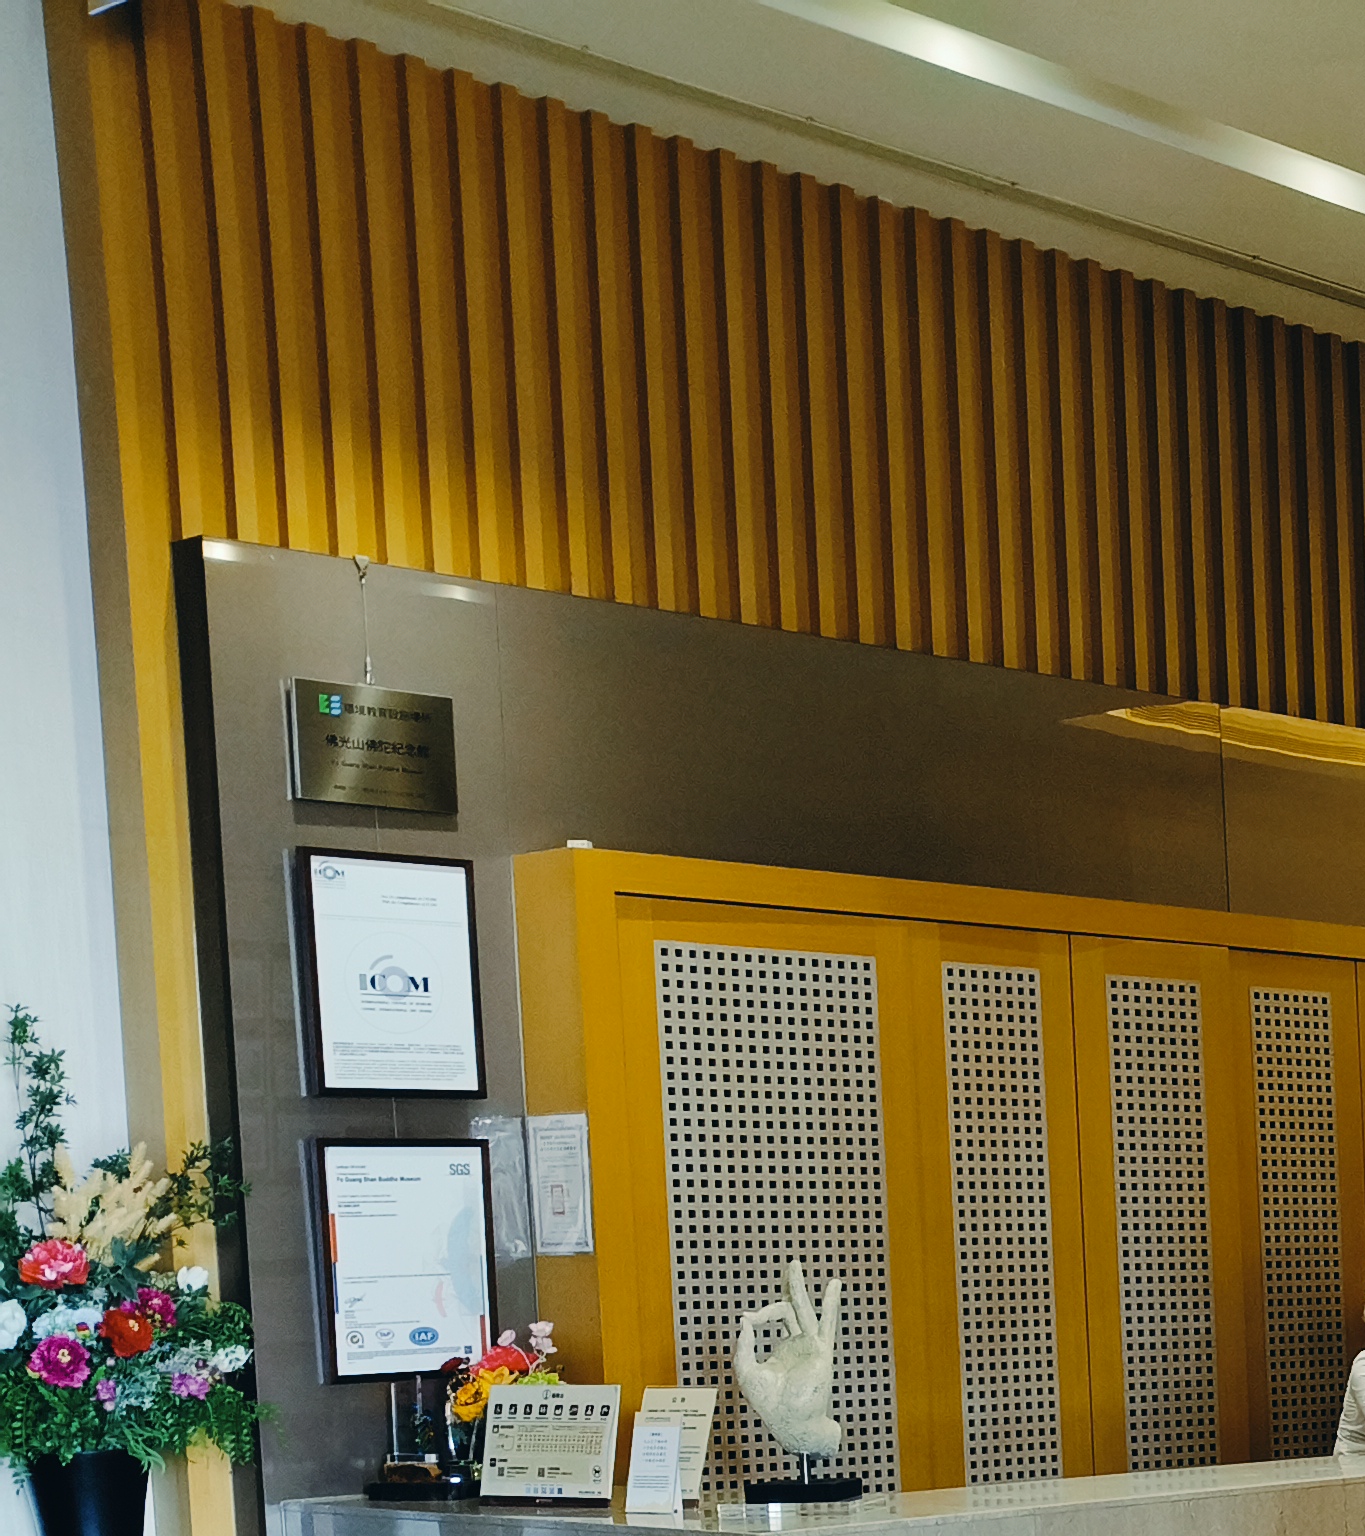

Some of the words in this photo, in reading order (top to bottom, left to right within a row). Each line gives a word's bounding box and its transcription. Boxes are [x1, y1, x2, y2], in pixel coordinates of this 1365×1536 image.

[359, 966, 431, 997] ICOM
[449, 1163, 470, 1176] SGS
[415, 1332, 434, 1340] IAF
